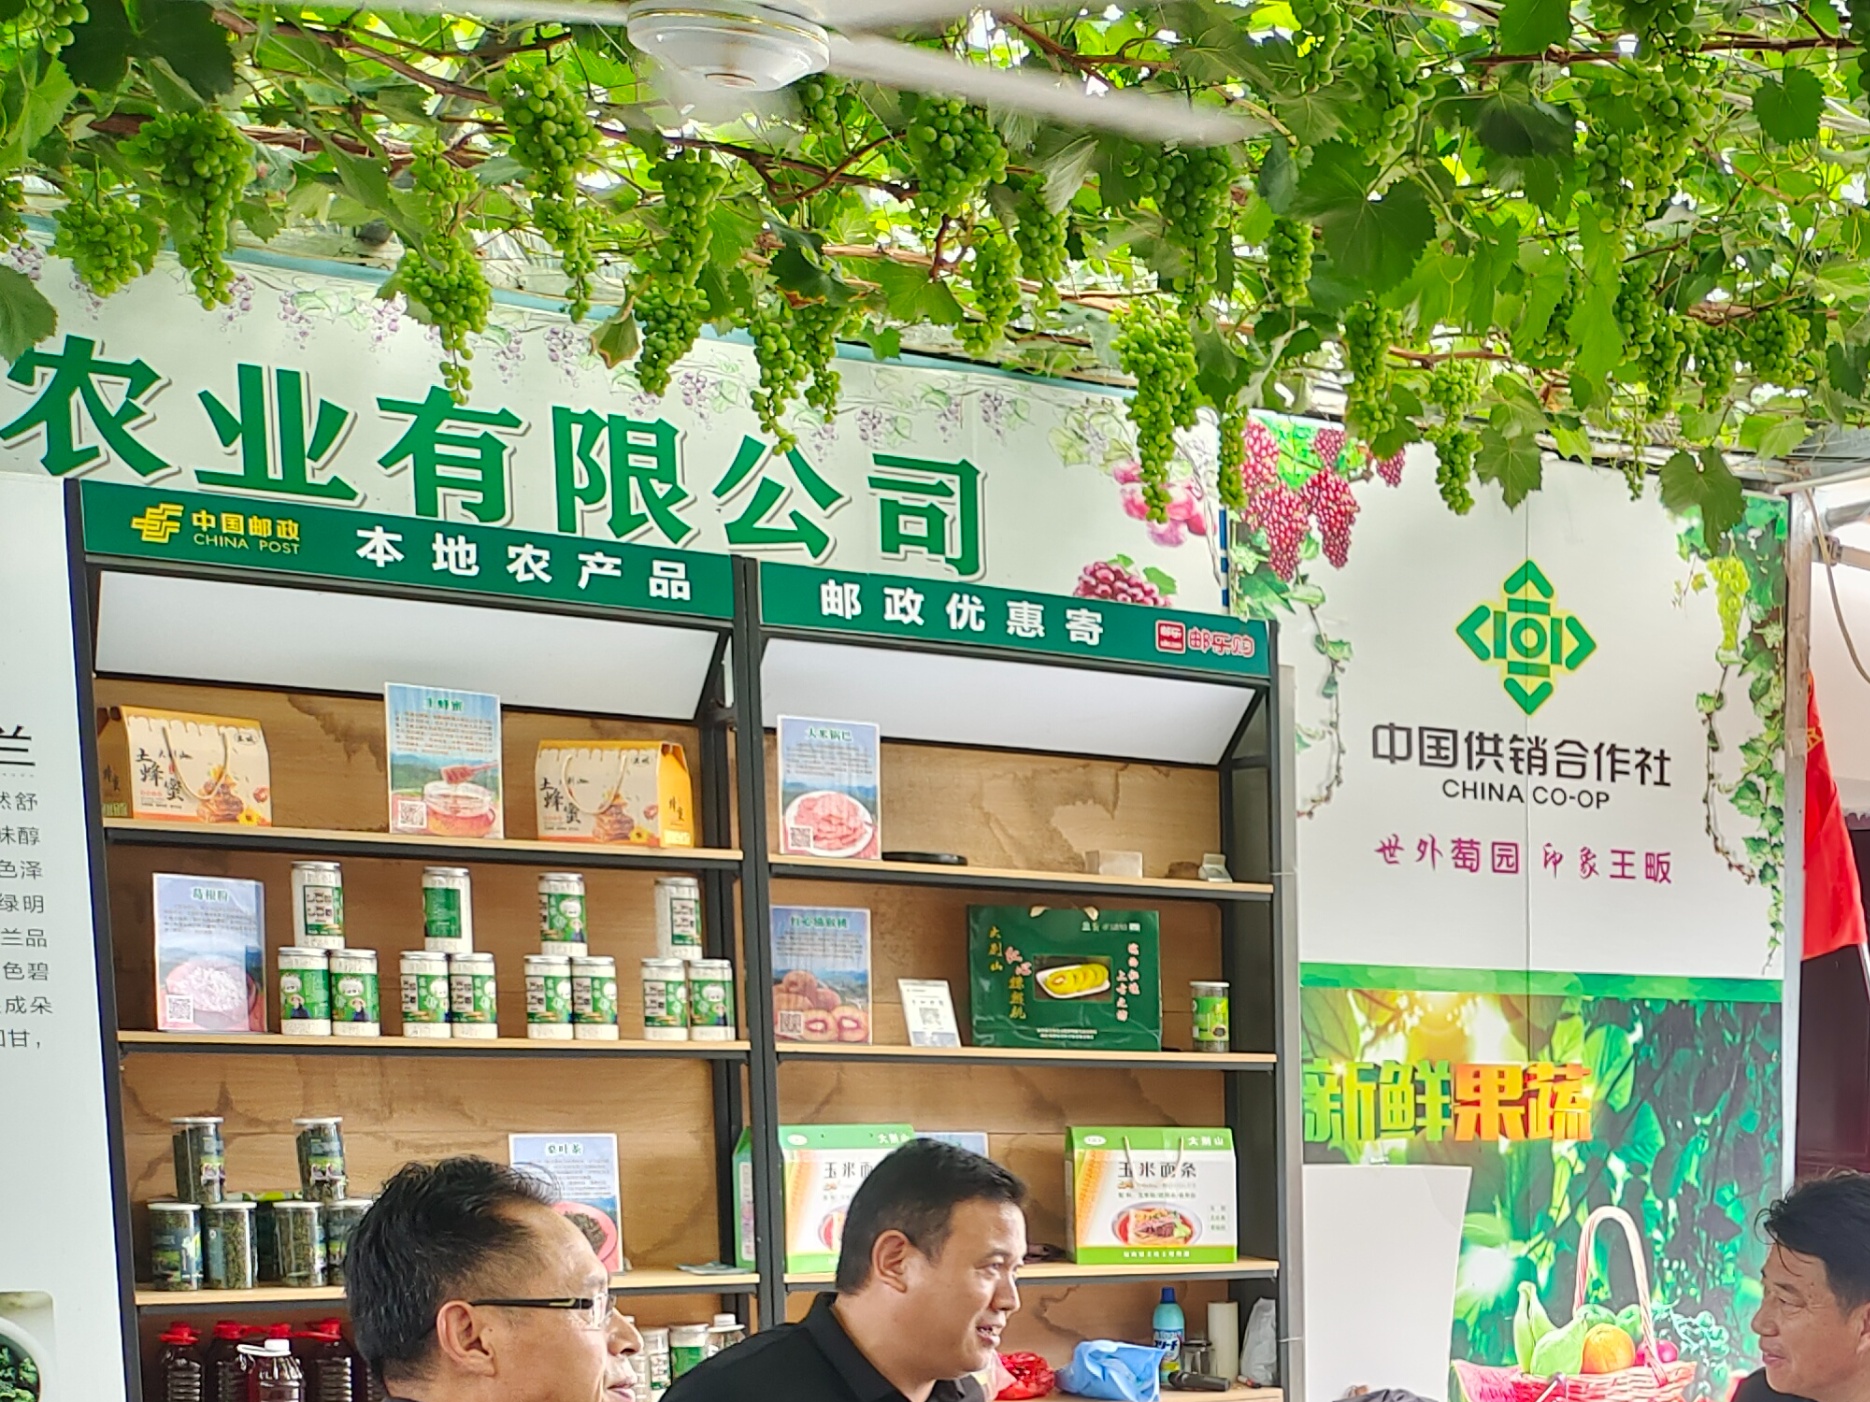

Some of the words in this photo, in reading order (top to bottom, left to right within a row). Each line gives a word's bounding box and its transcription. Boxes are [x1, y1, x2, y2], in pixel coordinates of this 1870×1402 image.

[0, 333, 983, 577] 农业有限公司
[191, 510, 300, 541] 中国邮政
[193, 533, 249, 550] CHINA
[259, 540, 300, 555] POST
[356, 525, 691, 601] 本地农产品
[819, 579, 1103, 647] 邮政优惠寄
[1371, 722, 1672, 788] 中国供销合作社
[1442, 778, 1525, 804] CHINA
[1532, 785, 1610, 810] CO-OP
[0, 995, 53, 1016] 成朵
[1301, 1057, 1593, 1143] 新鲜果蔬
[1117, 1161, 1197, 1178] 玉米面条
